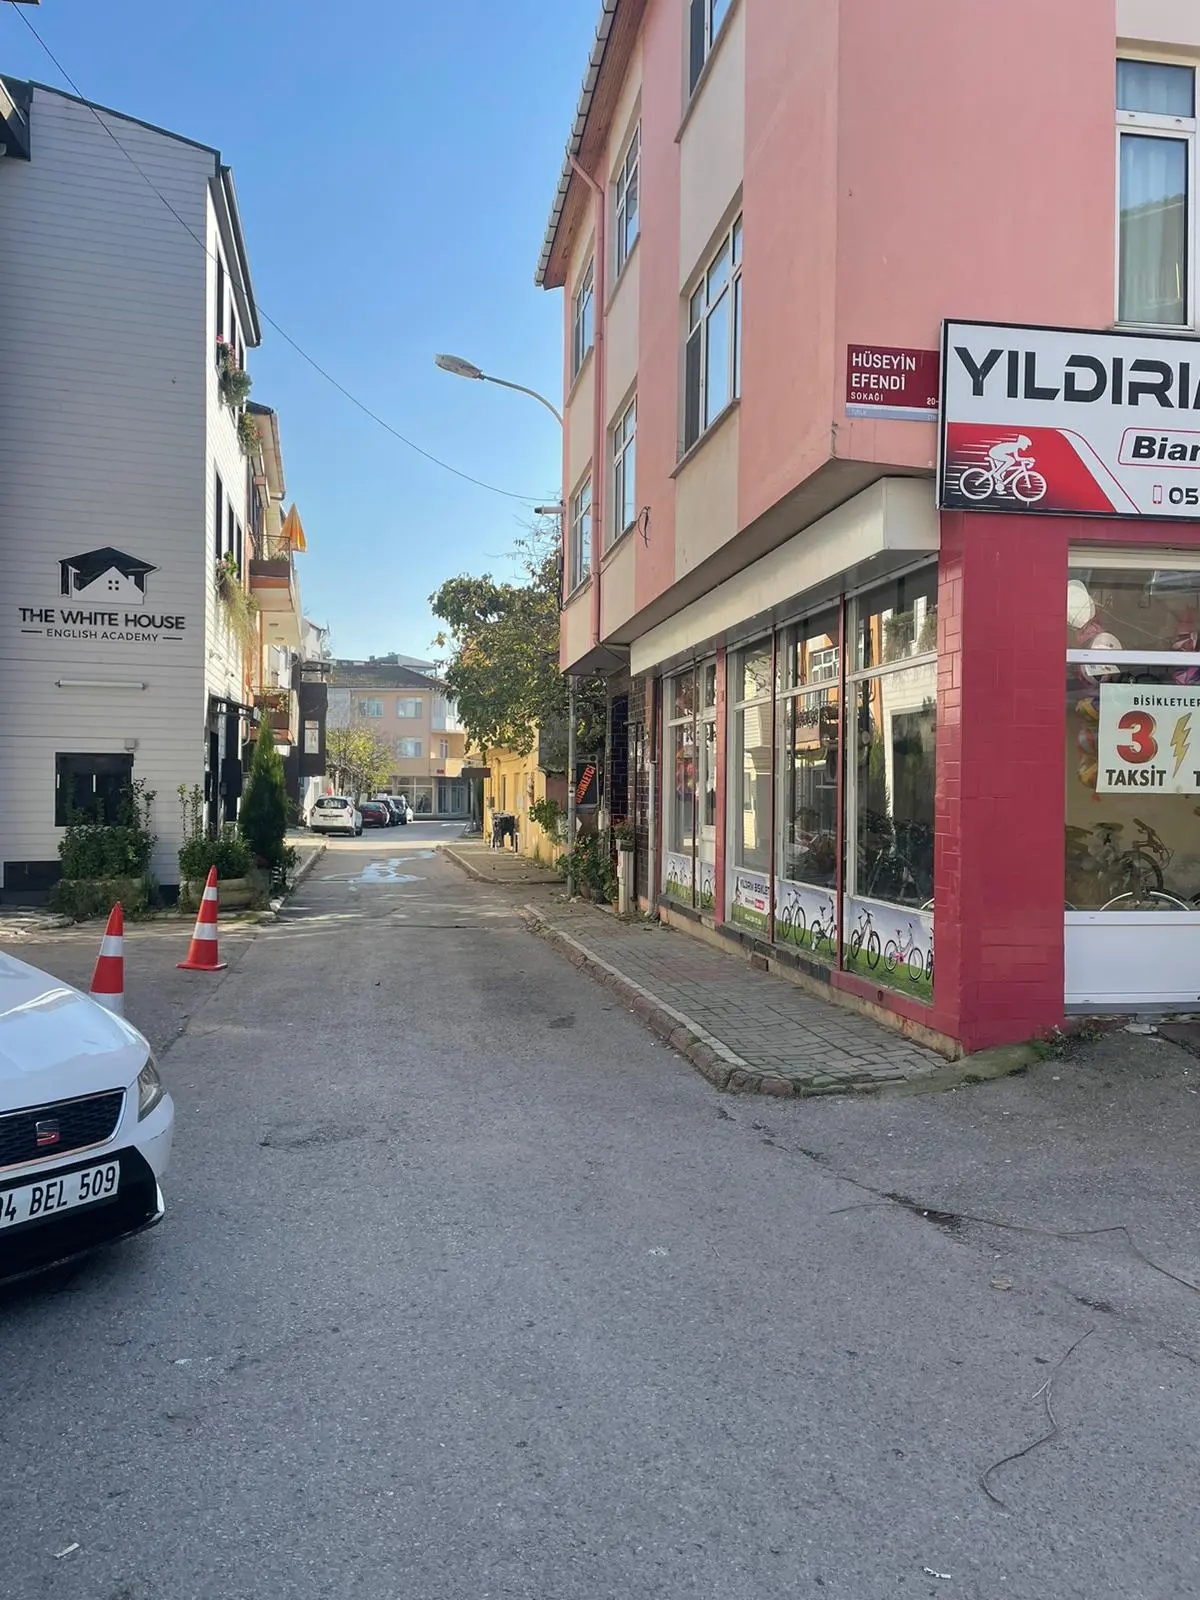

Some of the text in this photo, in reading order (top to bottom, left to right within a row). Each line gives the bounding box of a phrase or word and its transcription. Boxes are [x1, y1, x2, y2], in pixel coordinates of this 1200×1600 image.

[852, 350, 916, 371] HÜSEYİN
[851, 373, 906, 391] EFENDİ
[954, 346, 1200, 410] YILDIRI
[1168, 486, 1200, 505] 05
[18, 607, 186, 630] THE WHITE HOUSE
[46, 628, 159, 642] ENGLISH ACADEMY
[1117, 711, 1158, 764] 3
[1105, 764, 1167, 787] TAKSİT
[29, 1180, 67, 1216] BEL
[79, 1166, 115, 1200] 509
